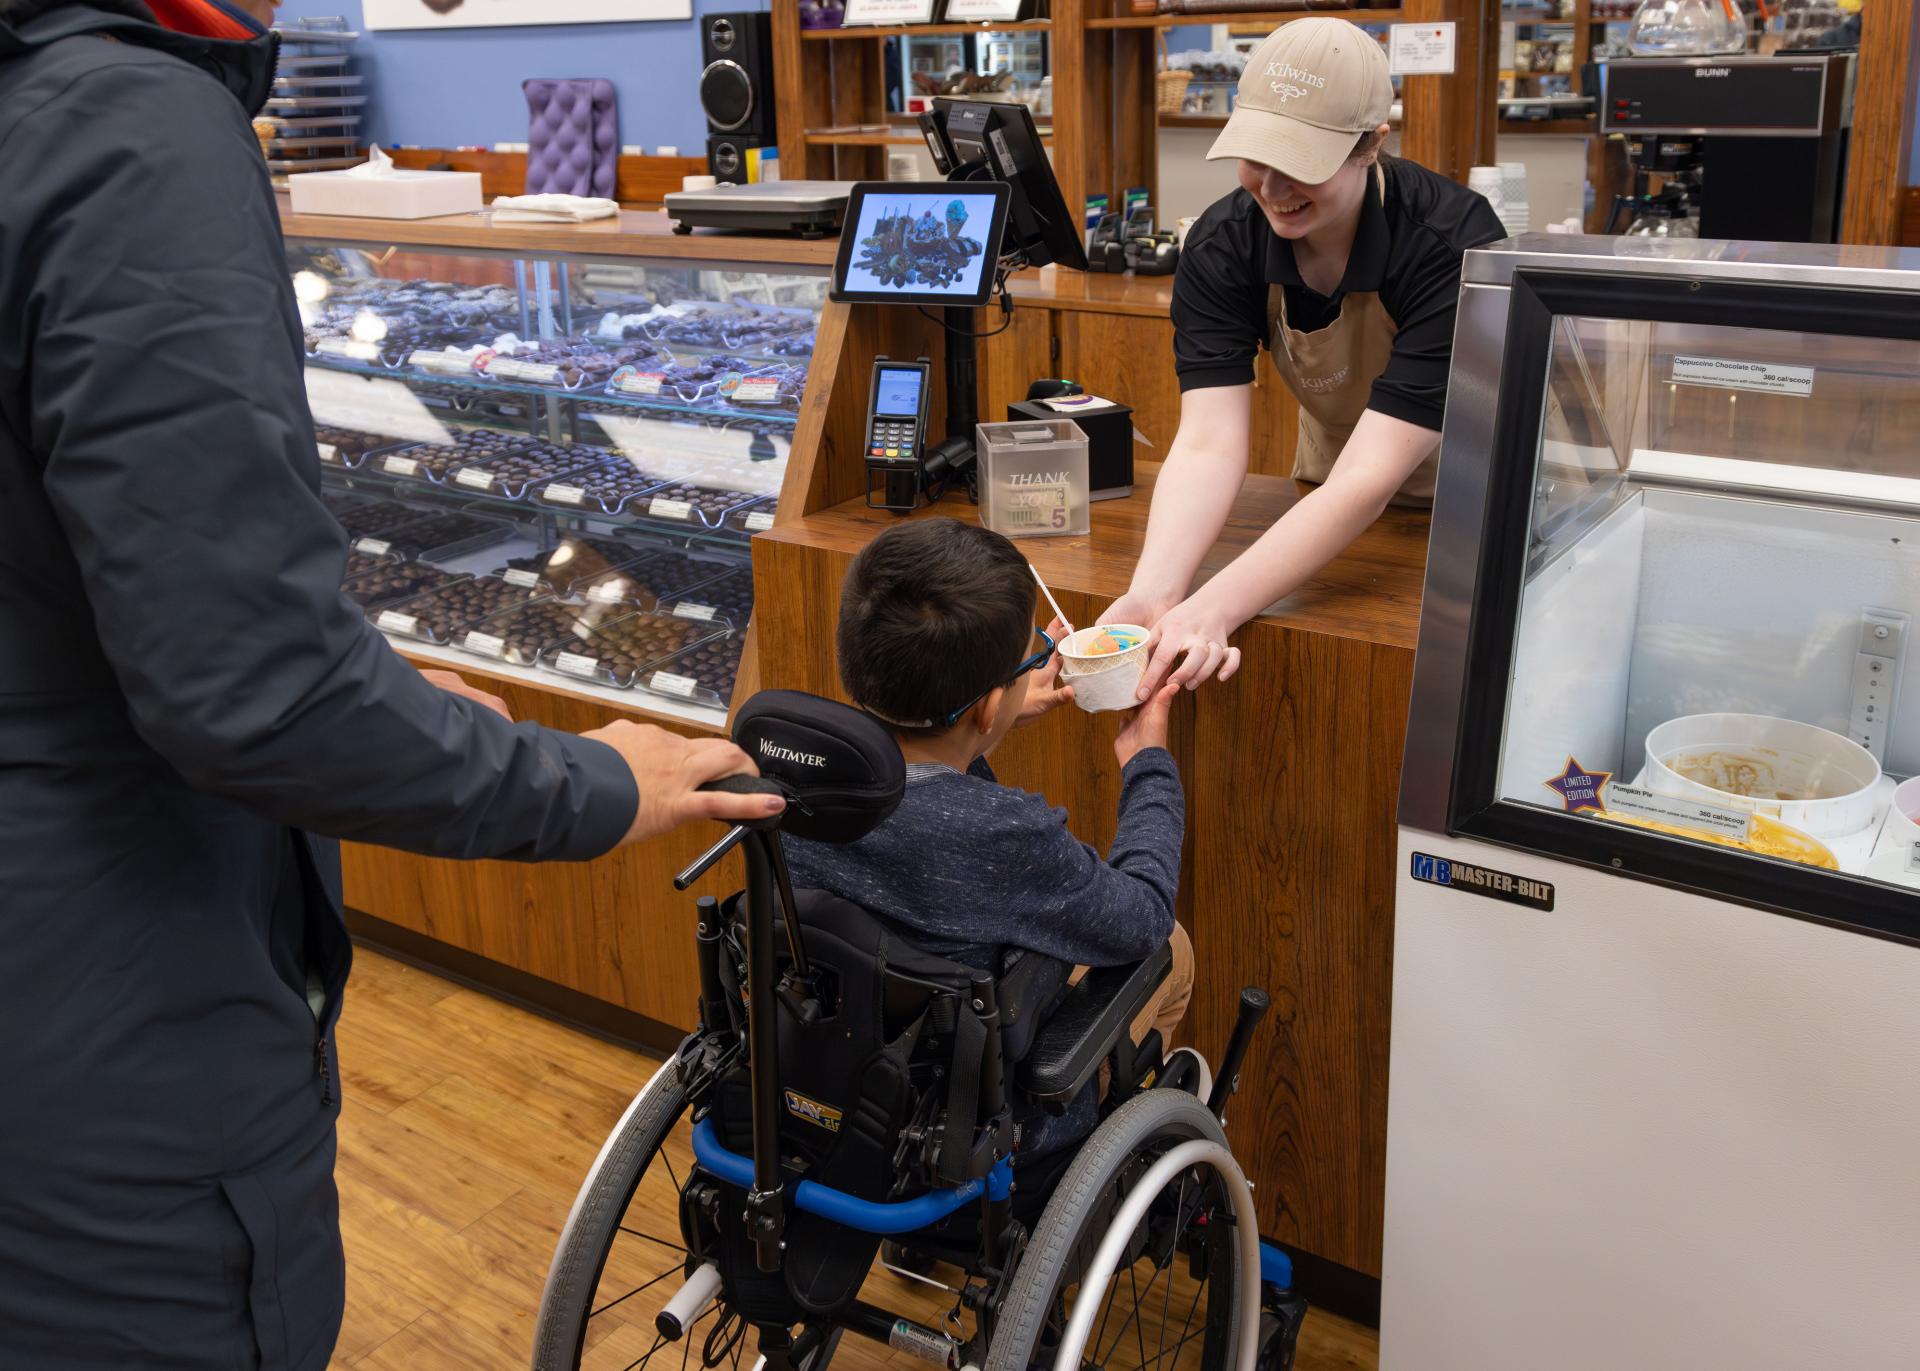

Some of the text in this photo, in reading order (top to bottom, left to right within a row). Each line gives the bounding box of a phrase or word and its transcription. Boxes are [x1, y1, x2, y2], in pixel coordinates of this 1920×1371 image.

[1264, 62, 1326, 88] Kilwins
[1695, 68, 1730, 78] BUNN
[1674, 357, 1767, 373] Cappuccino Chocolate Chip
[1777, 375, 1811, 386] cal/scoop
[1009, 471, 1070, 487] THANK
[1052, 508, 1066, 529] 5
[760, 737, 826, 768] WHITMYER
[1563, 775, 1592, 788] LIMITED
[1566, 788, 1595, 801] EDITION
[1613, 784, 1653, 798] Pumpkin Pie
[1712, 812, 1745, 825] cal/scoop
[1451, 863, 1551, 901] MASTER-BILT
[790, 1096, 822, 1120] JAY
